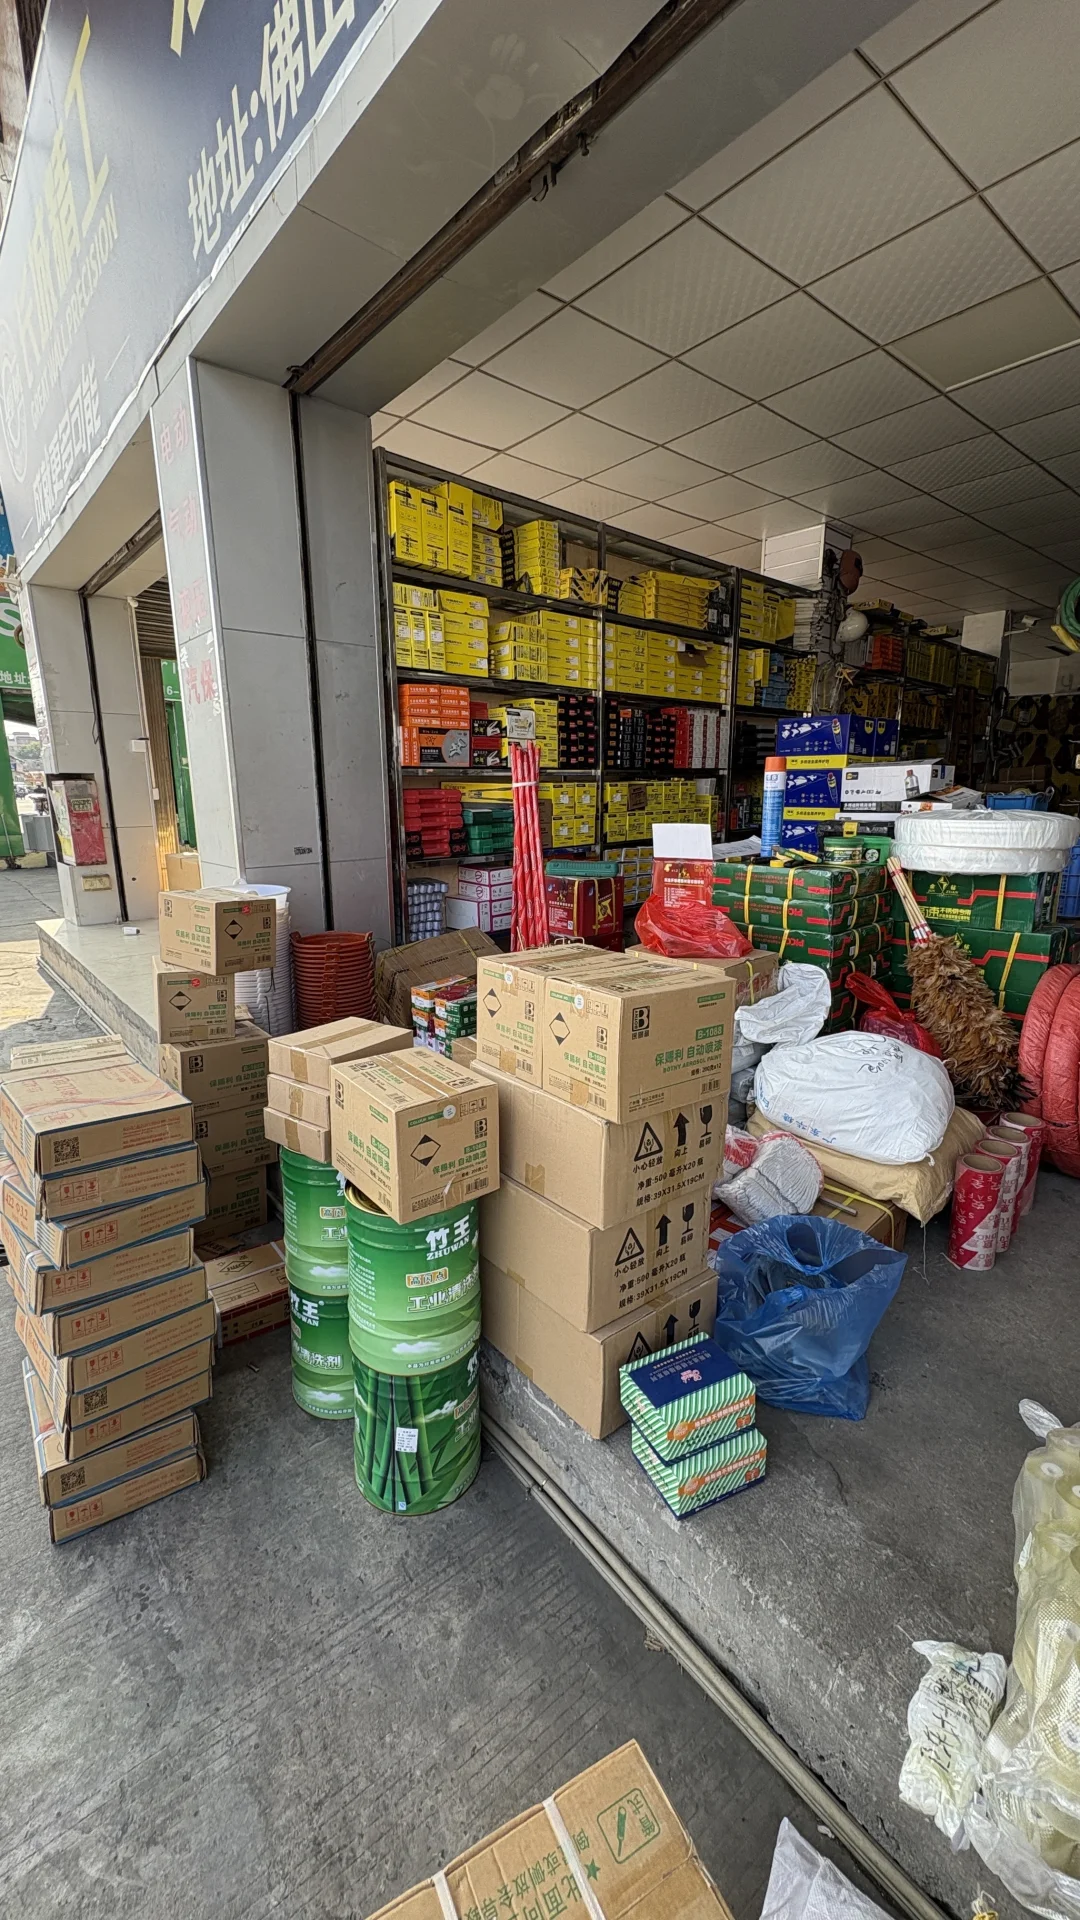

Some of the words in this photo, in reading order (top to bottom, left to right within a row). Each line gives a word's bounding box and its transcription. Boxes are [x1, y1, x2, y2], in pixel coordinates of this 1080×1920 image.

[66, 193, 118, 344] PRECISION
[697, 1027, 722, 1039] B-1088
[687, 1039, 723, 1059] 自动喷漆
[663, 1064, 682, 1073] BOTNY
[682, 1058, 706, 1069] AEROSOL
[365, 1146, 390, 1173] 自动喷漆
[458, 1150, 487, 1167] 自动喷漆
[632, 1156, 663, 1174] 小心轻放
[674, 1147, 688, 1158] 向上
[637, 1172, 668, 1191] 净重:500
[669, 1161, 696, 1177] 毫升X20
[425, 1213, 471, 1252] 竹王
[426, 1235, 470, 1261] ZHUWAN
[614, 1257, 645, 1278] 小心轻放
[655, 1245, 670, 1258] 向上
[619, 1272, 650, 1293] 净重:500
[651, 1258, 678, 1277] 毫升X20
